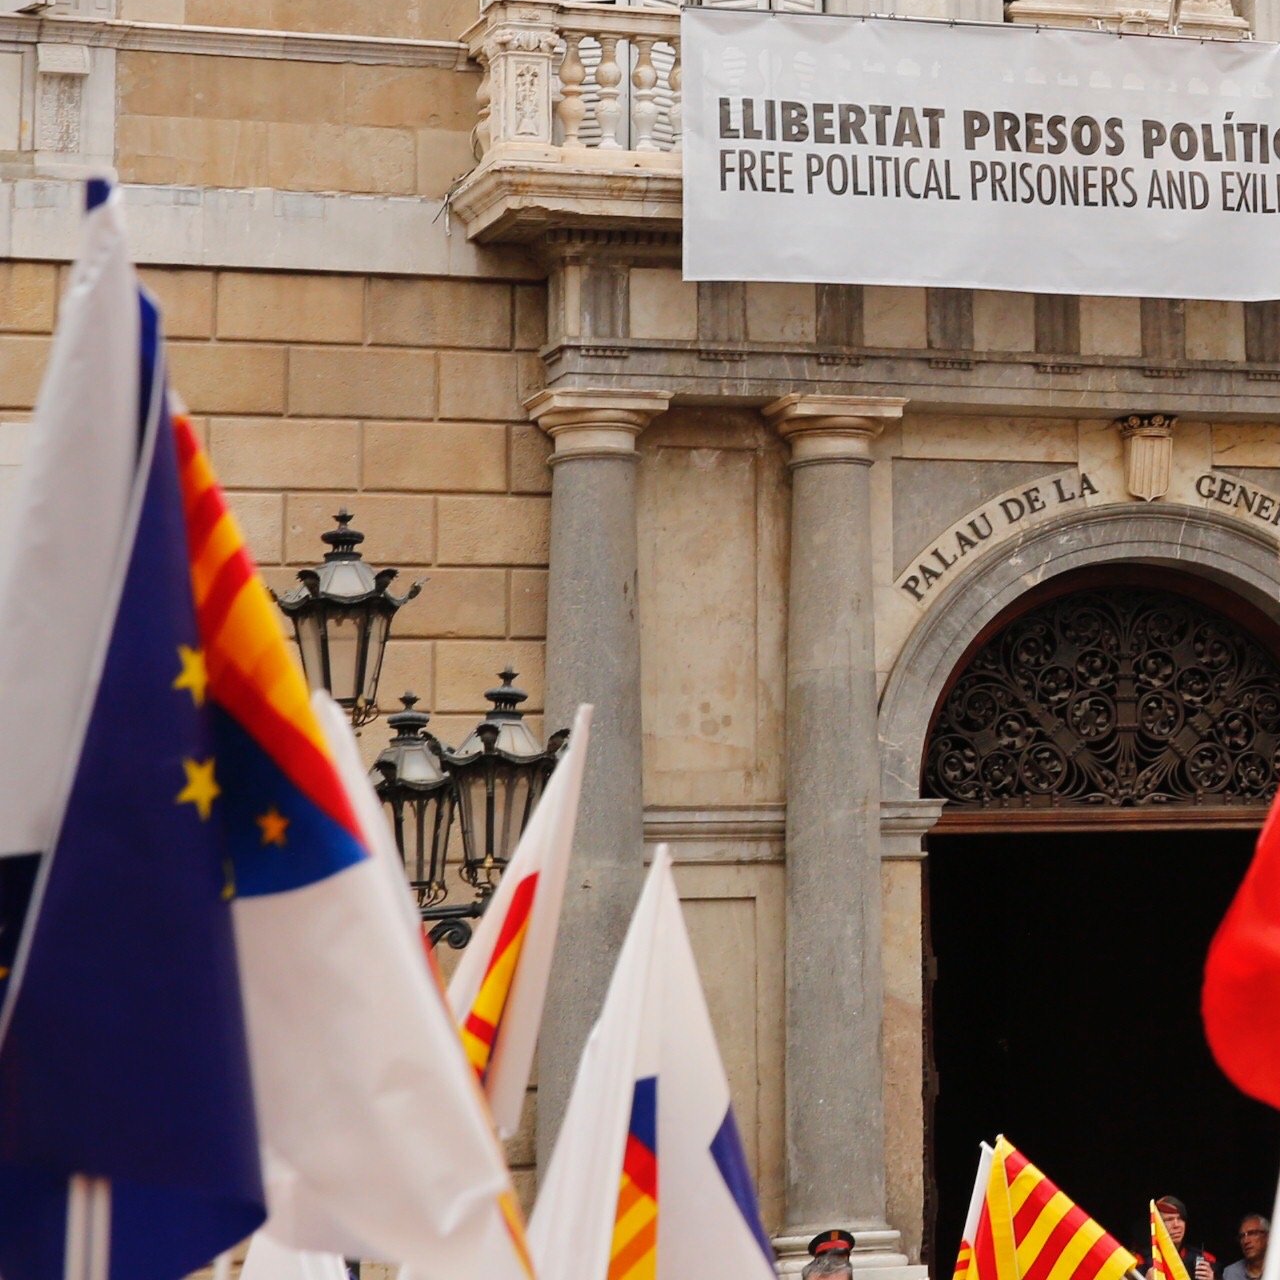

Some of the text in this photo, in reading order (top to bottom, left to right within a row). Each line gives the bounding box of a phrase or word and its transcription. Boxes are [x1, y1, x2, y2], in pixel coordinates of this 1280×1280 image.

[719, 97, 946, 149] LLIBERTAT
[963, 110, 1125, 157] PRESOS
[719, 149, 795, 194] FREE
[806, 153, 961, 202] POLITICAL
[970, 160, 1138, 209] PRISONERS
[1147, 169, 1210, 210] AND
[901, 513, 993, 602] PALAU
[999, 486, 1046, 524] DE
[1052, 473, 1099, 503] LA
